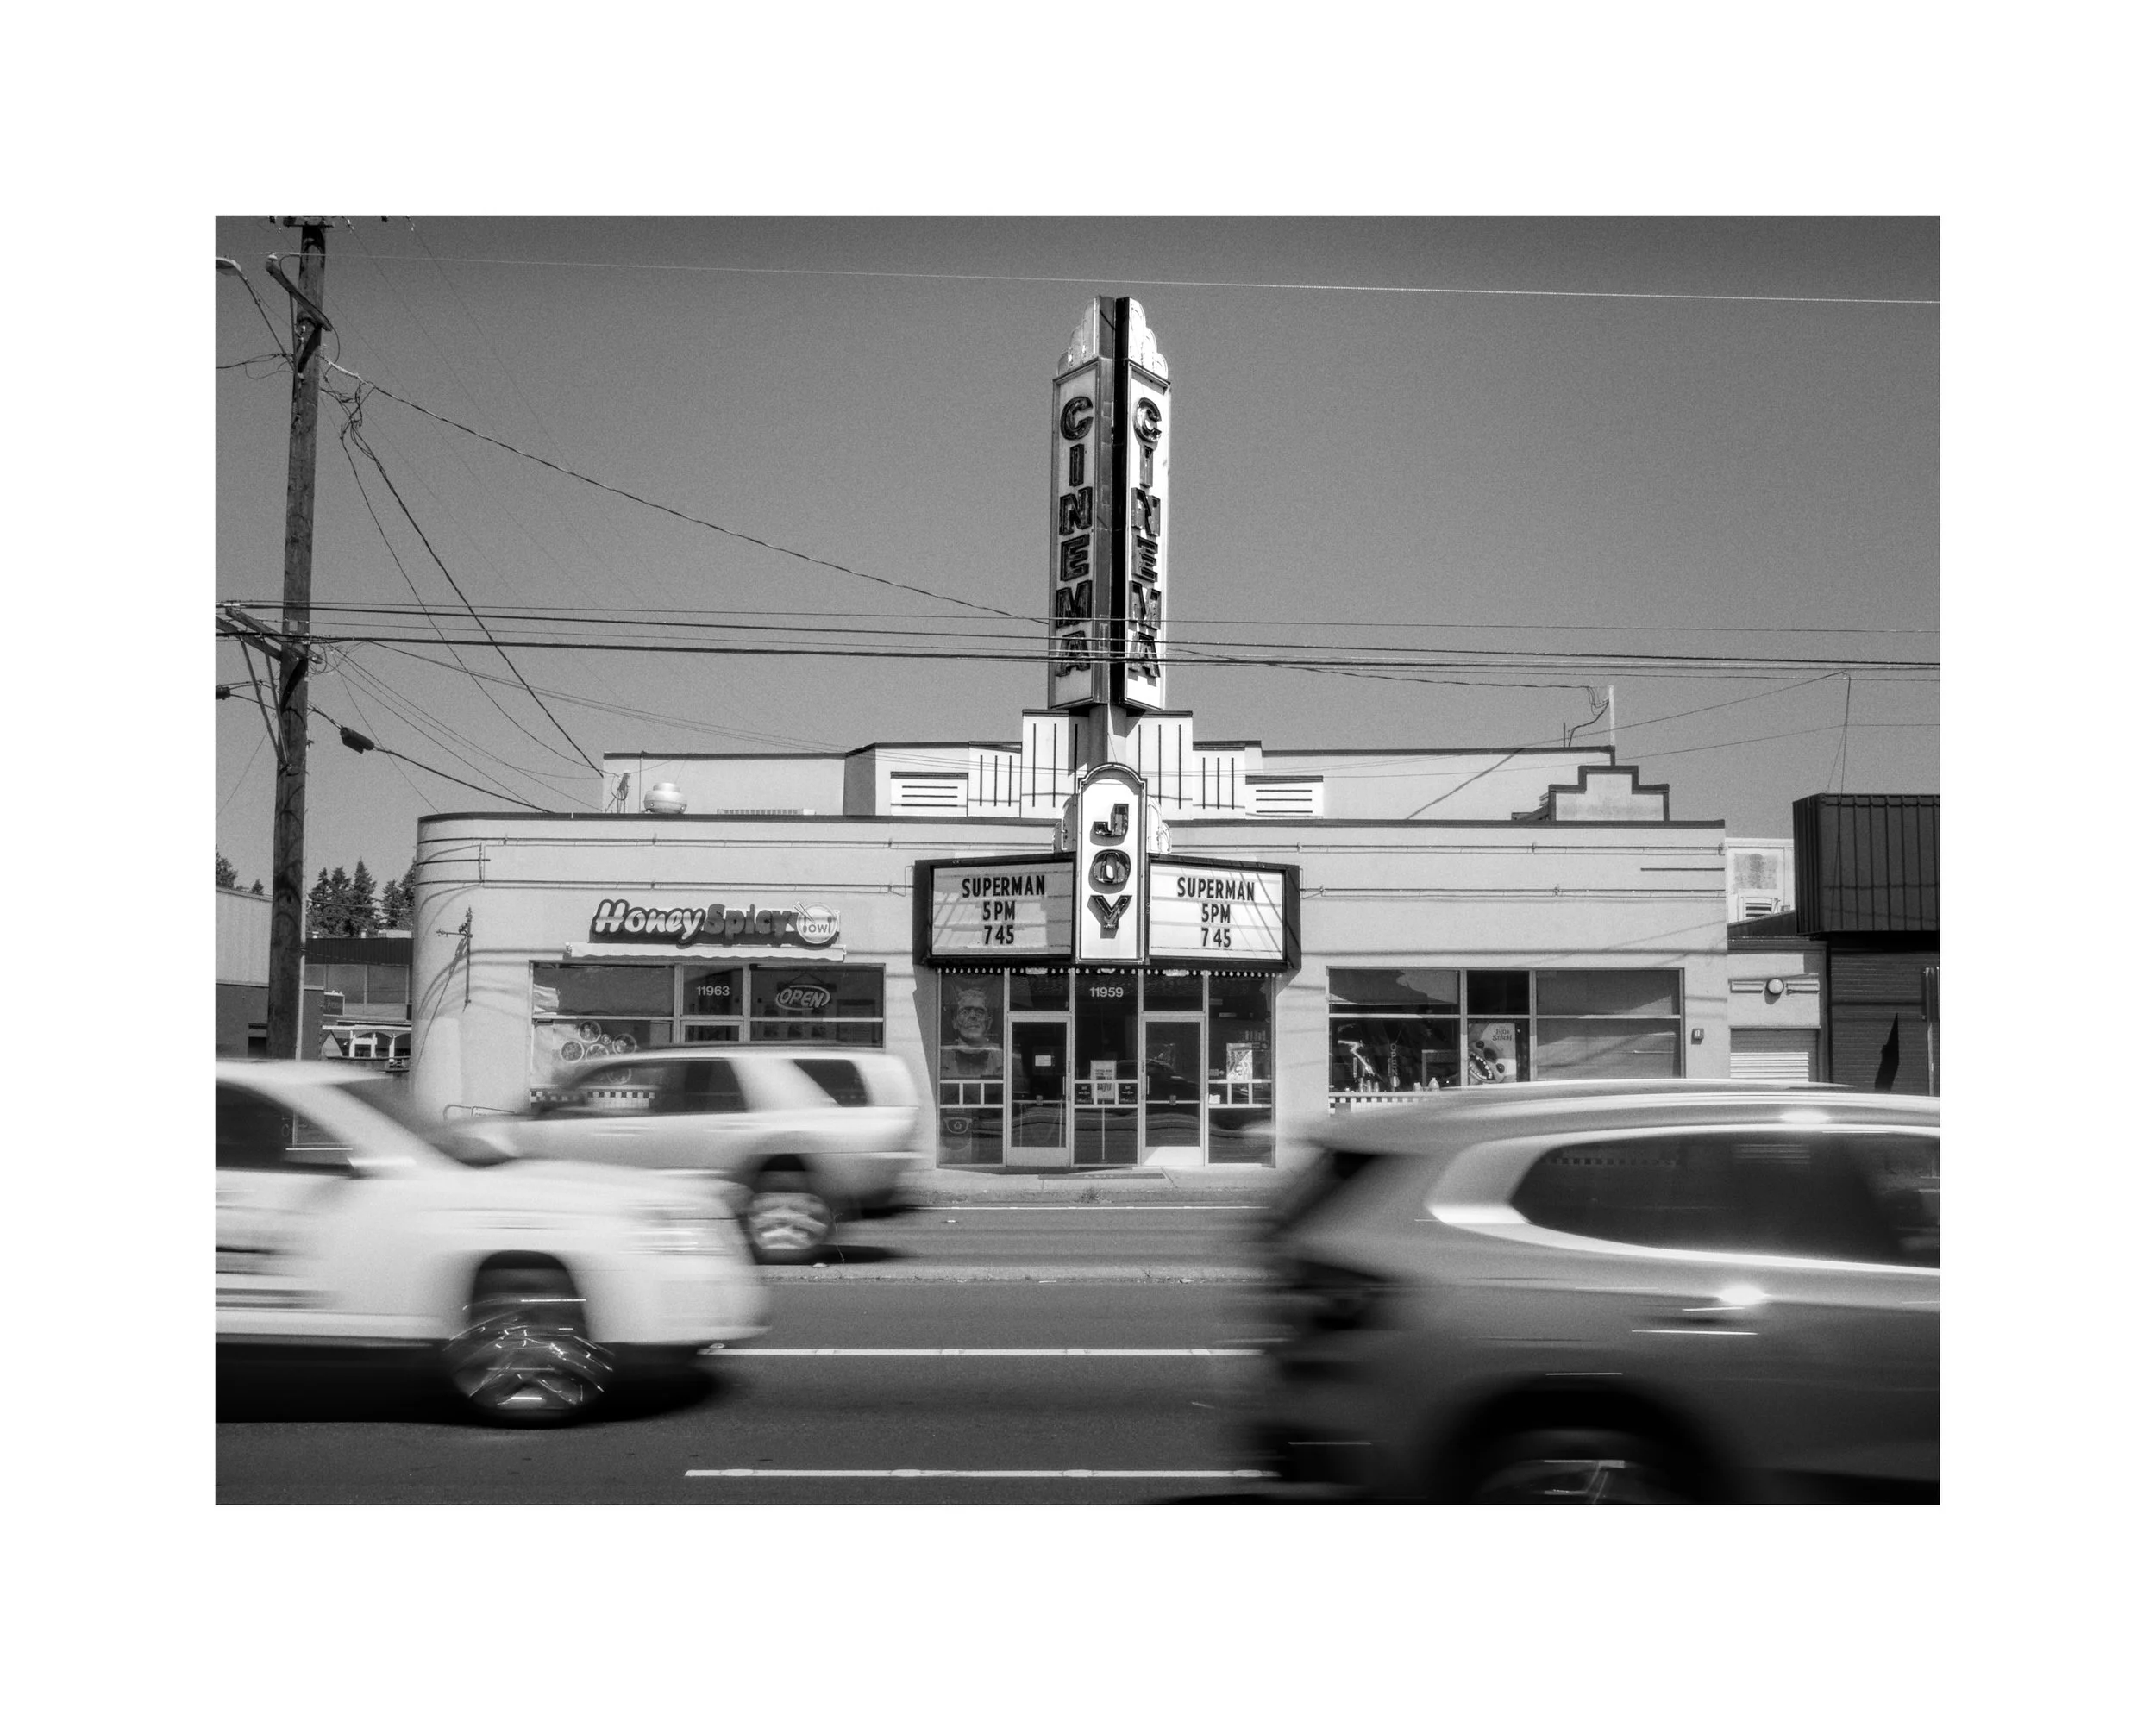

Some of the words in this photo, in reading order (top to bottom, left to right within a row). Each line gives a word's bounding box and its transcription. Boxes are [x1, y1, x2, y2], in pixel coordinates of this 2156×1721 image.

[1055, 396, 1094, 677] CINEMA
[1130, 397, 1161, 679] CINEMA
[1088, 803, 1133, 935] JOY
[962, 875, 1045, 898] SUPERMAN
[1176, 876, 1255, 901] SUPERMAN
[593, 899, 704, 943] Honey
[704, 904, 793, 941] Spicy
[697, 986, 730, 996] 11963
[779, 988, 824, 1007] OPEN
[1089, 986, 1124, 998] 11959
